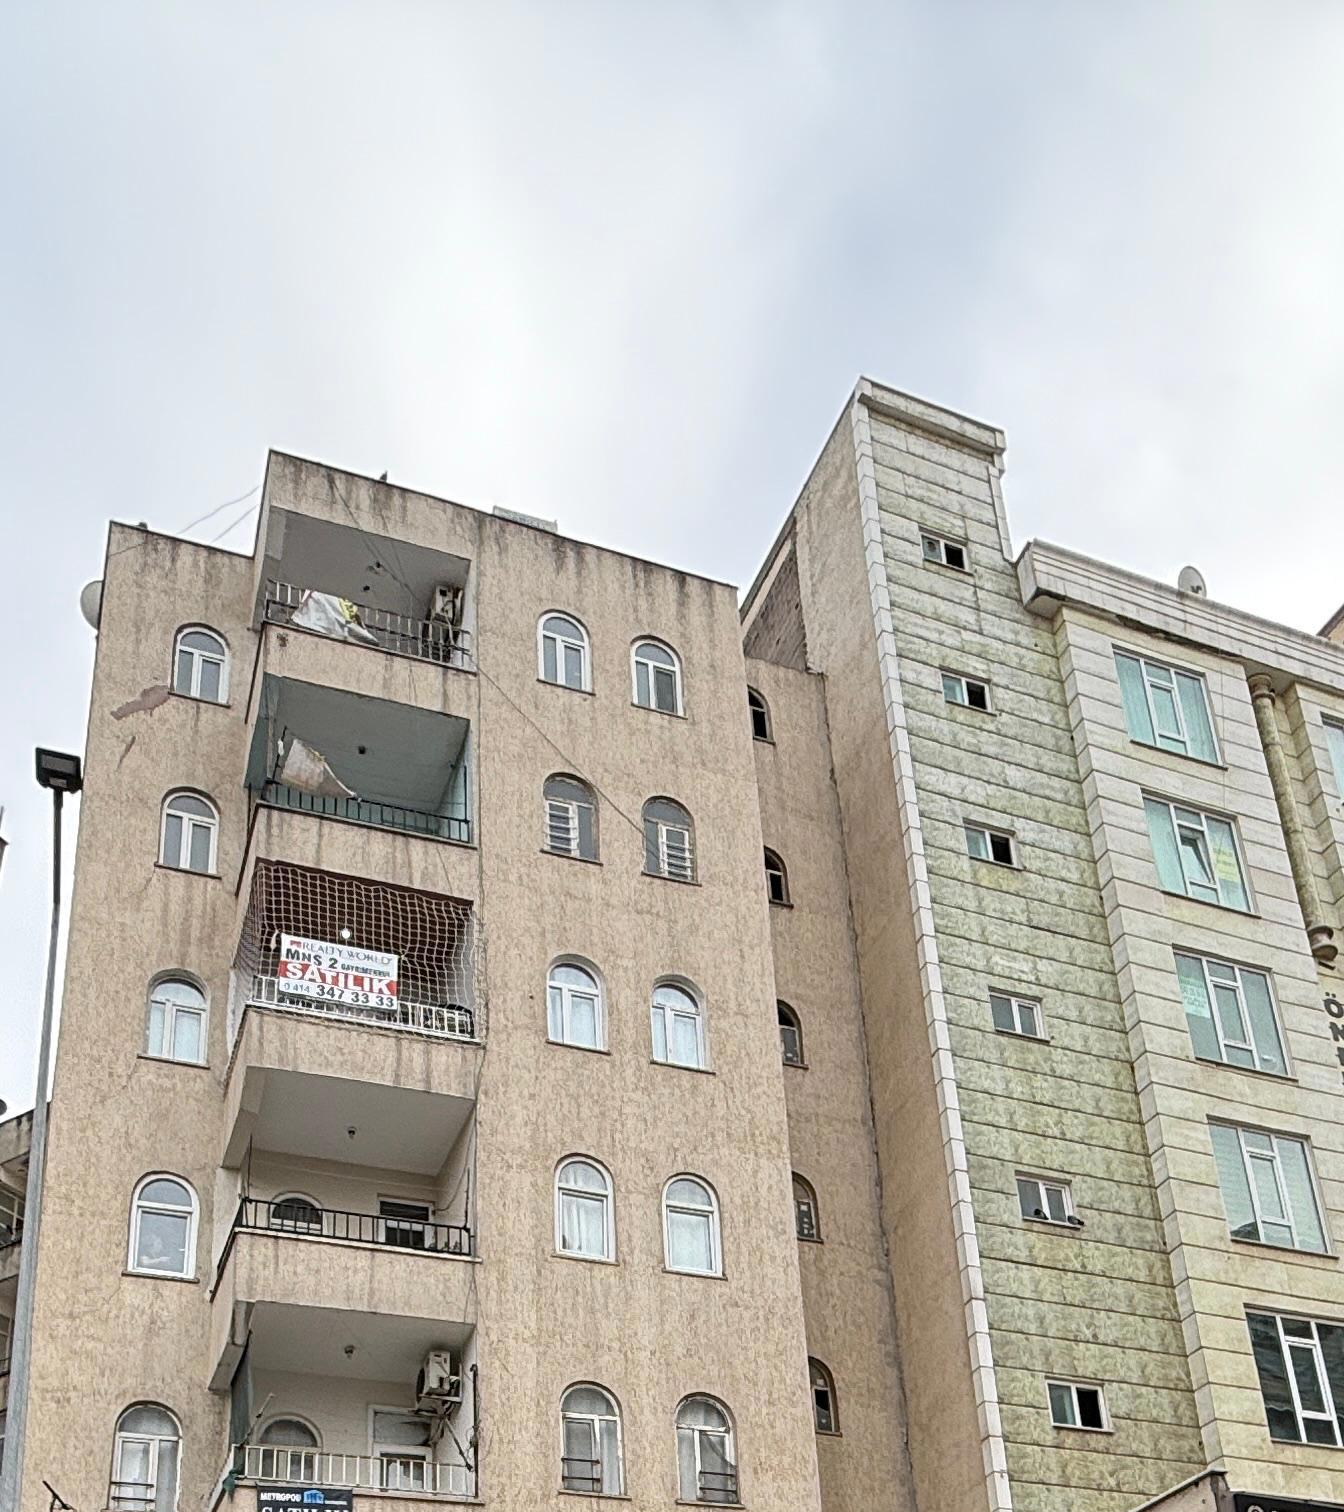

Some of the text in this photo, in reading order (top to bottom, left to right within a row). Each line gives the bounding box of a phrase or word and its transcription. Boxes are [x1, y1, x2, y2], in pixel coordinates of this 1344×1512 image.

[285, 948, 322, 967] MNS
[328, 957, 339, 969] 2
[302, 940, 344, 956] REALTY
[347, 950, 393, 965] WORLD
[286, 962, 392, 996] SATILIK
[316, 984, 345, 1000] 347
[351, 991, 370, 1004] 33
[375, 996, 395, 1008] 33
